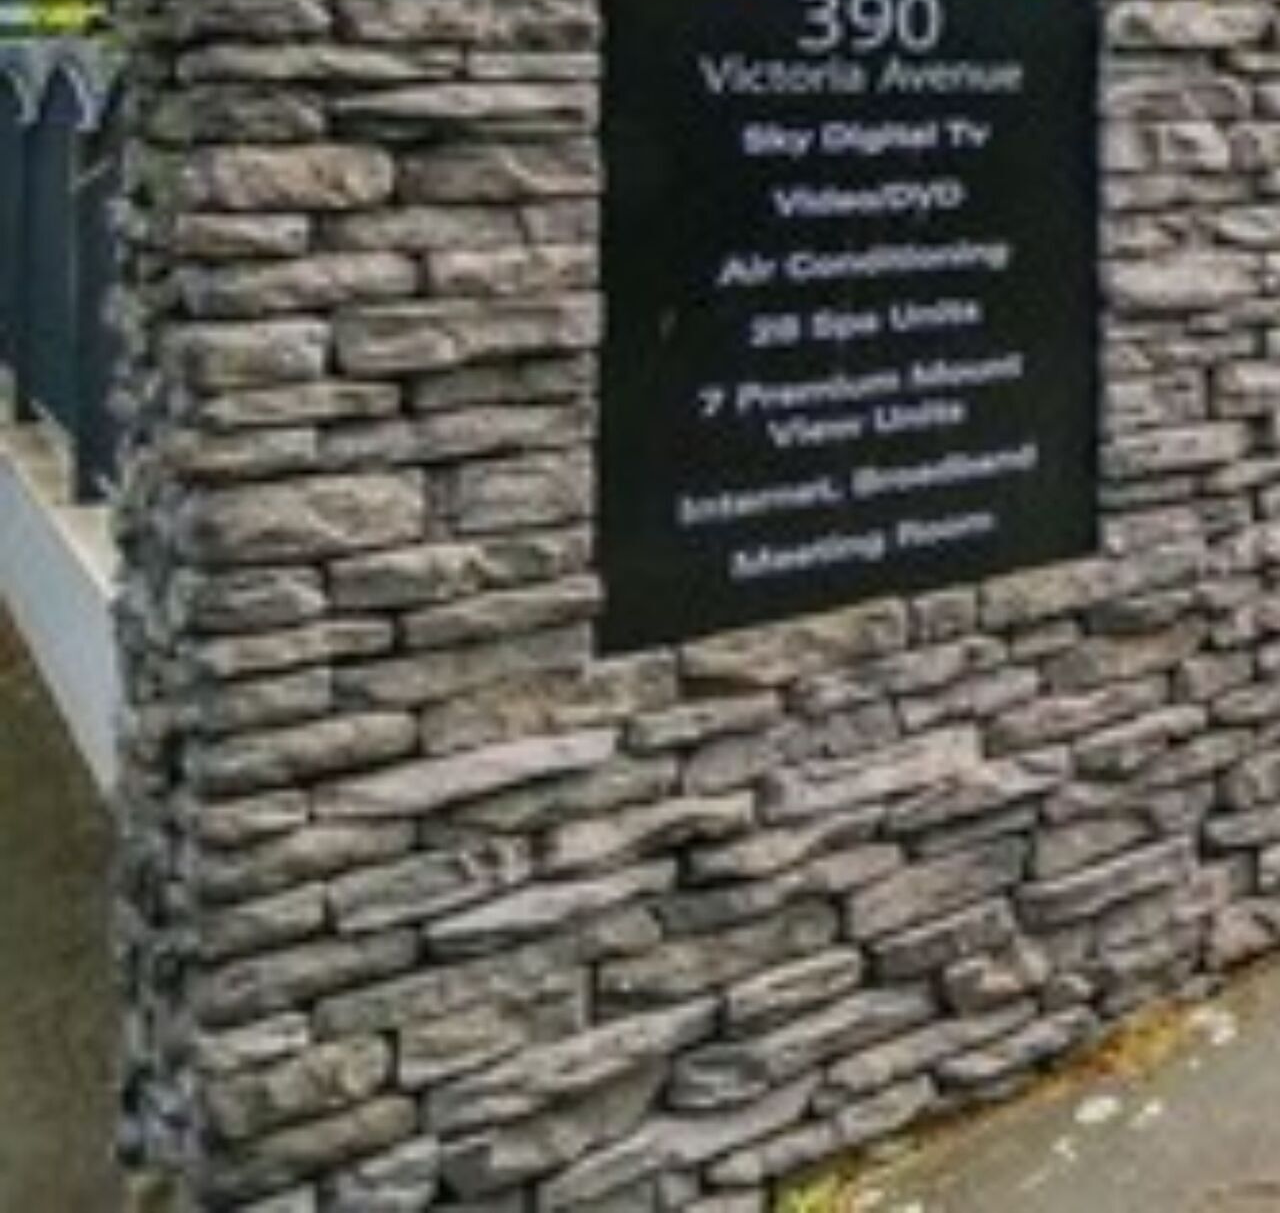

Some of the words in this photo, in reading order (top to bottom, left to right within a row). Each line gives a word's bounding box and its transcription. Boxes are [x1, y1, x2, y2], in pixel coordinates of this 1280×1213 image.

[699, 53, 864, 93] Victoria
[876, 55, 1024, 92] Avenue
[715, 254, 776, 285] Air
[784, 242, 1010, 282] Conditioning
[888, 297, 983, 332] Units
[697, 387, 724, 417] 7
[766, 416, 862, 447] View
[873, 398, 967, 433] Units
[852, 442, 1038, 494] Broadband
[730, 530, 886, 579] Meeting
[896, 512, 995, 546] Room
